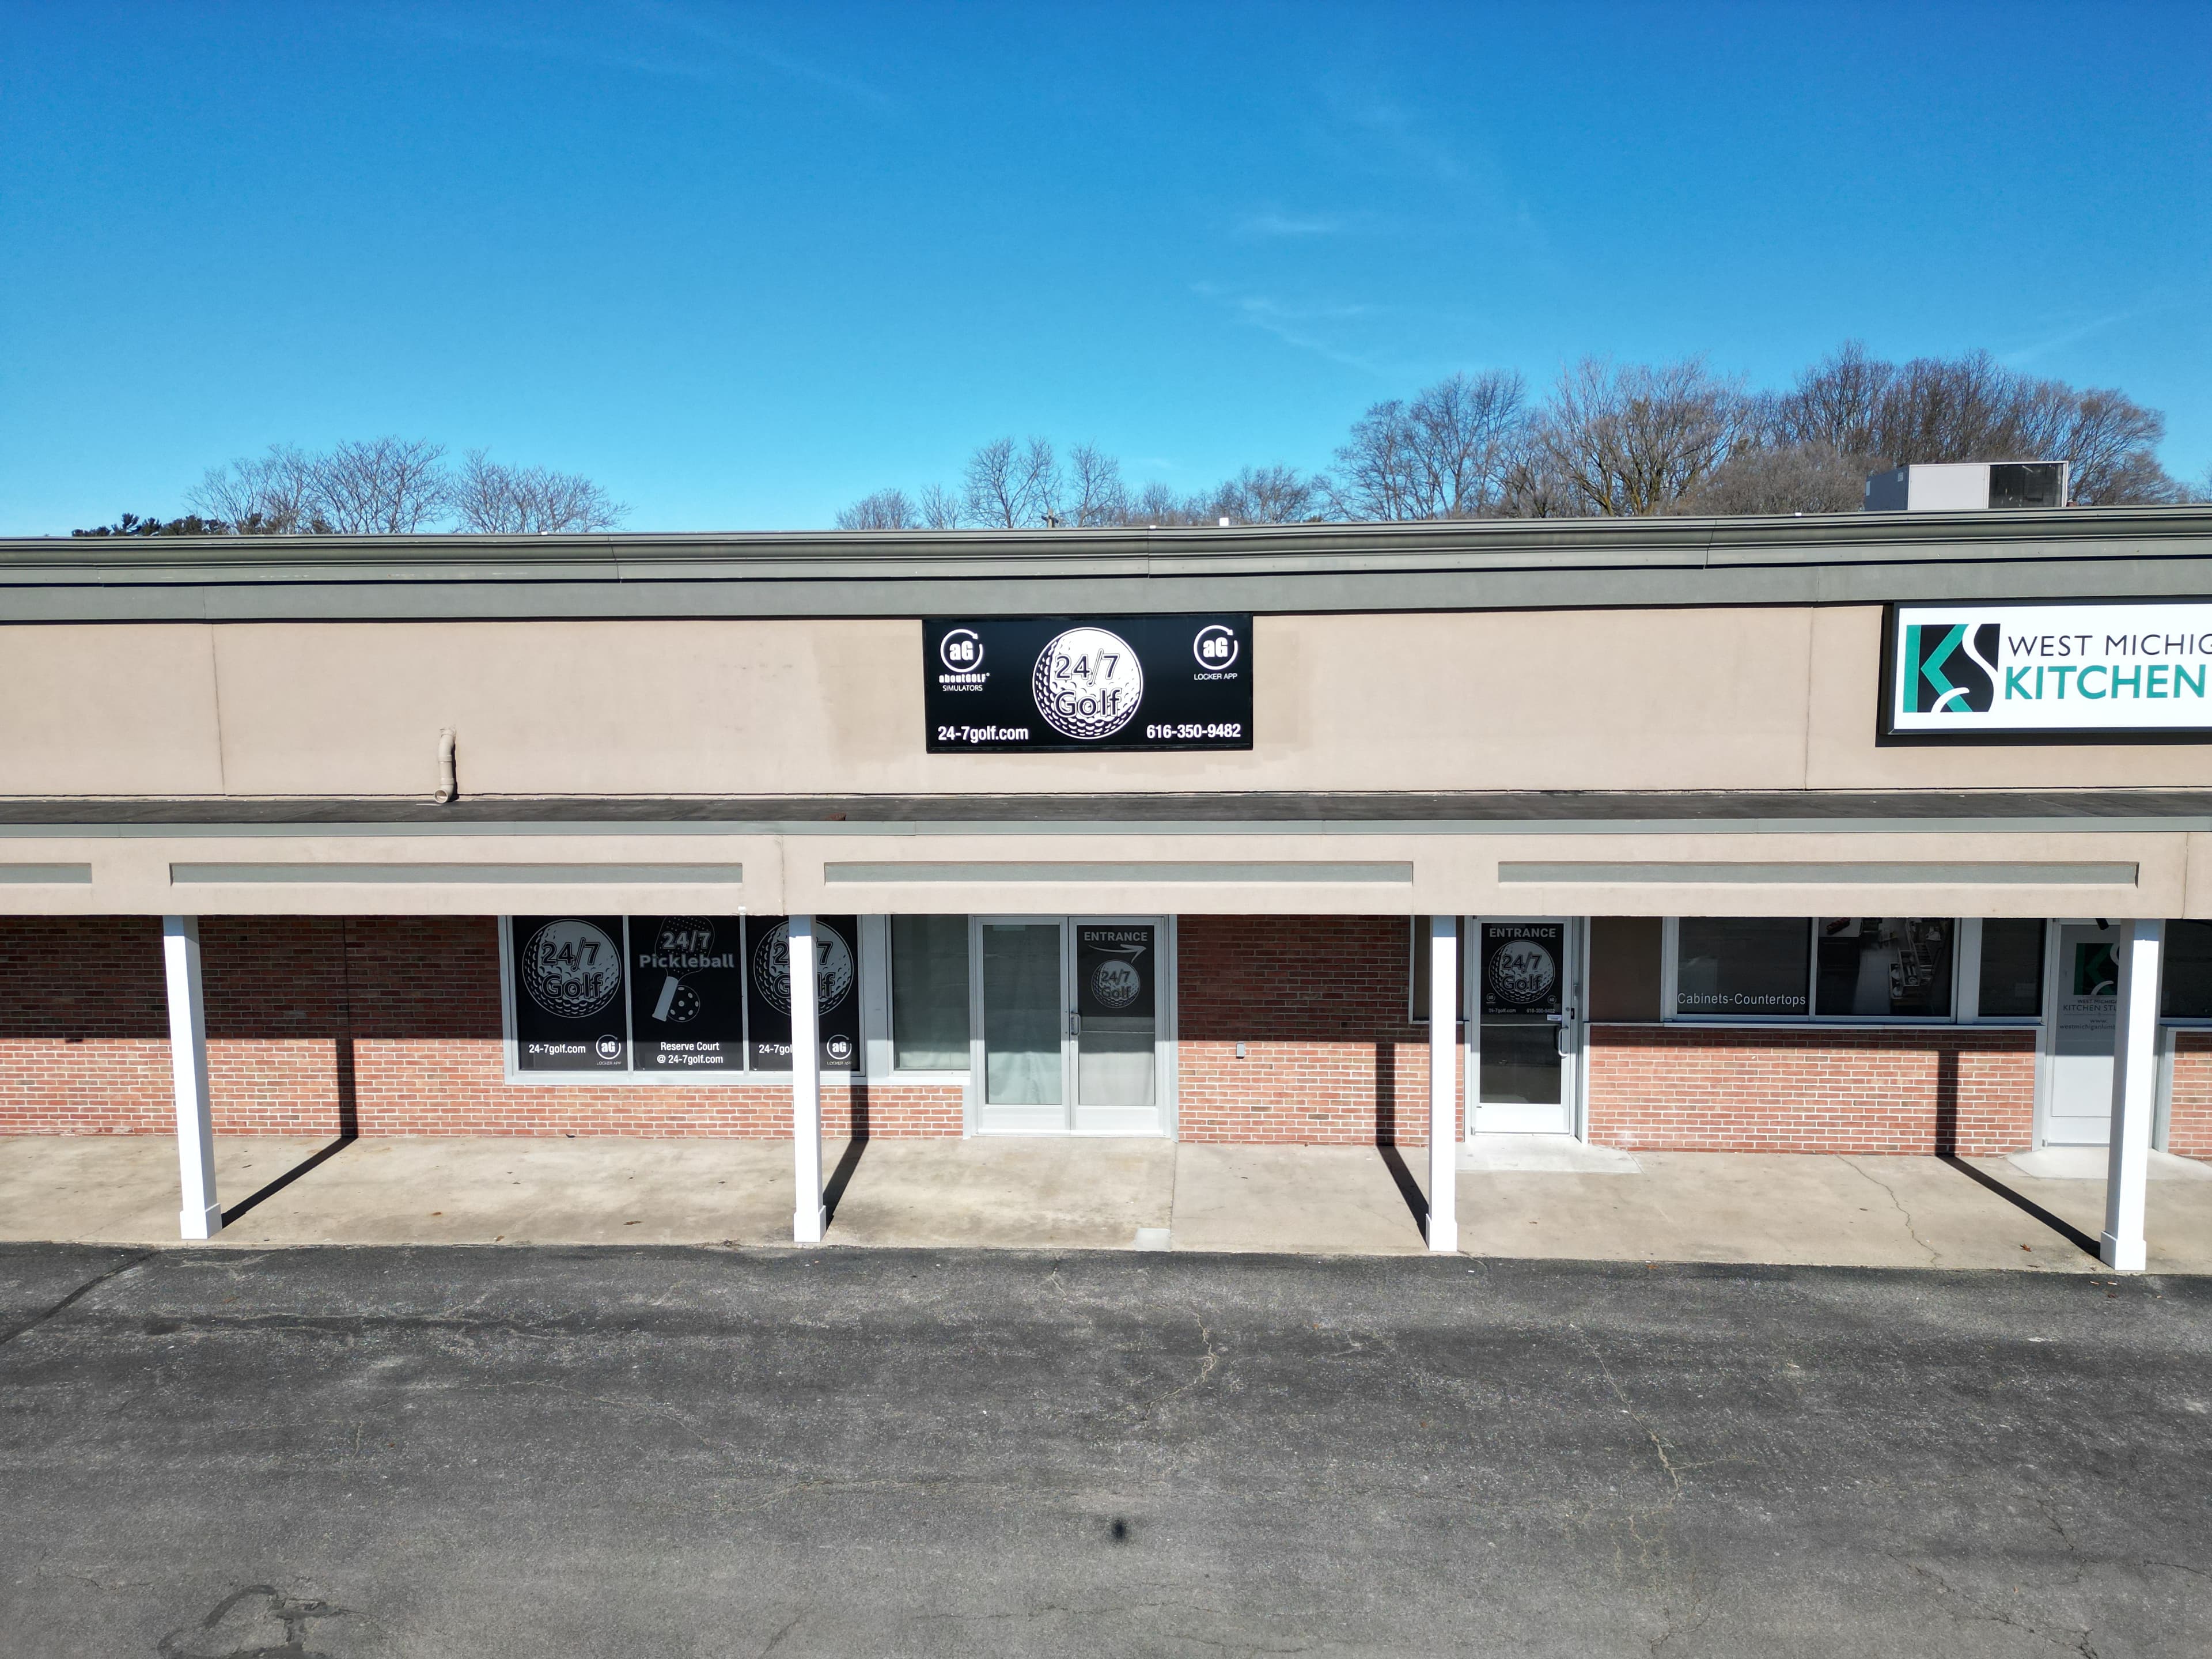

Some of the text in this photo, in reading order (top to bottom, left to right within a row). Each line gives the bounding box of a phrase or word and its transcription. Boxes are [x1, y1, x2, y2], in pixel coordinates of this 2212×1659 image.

[949, 641, 973, 660] aG
[1203, 637, 1228, 657] aG
[2008, 634, 2212, 657] WEST MICHIG
[1055, 648, 1120, 687] 24/7
[2005, 664, 2206, 699] KITCHEN
[1054, 688, 1123, 718] Golf
[938, 726, 1029, 743] 24-7golf.com
[1147, 724, 1241, 739] 616-350-9482
[662, 930, 711, 952] 24/7
[1084, 931, 1148, 941] ENTRANCE
[1489, 928, 1556, 938] ENTRANCE
[541, 937, 601, 972] 24/7
[639, 953, 735, 968] Pickleball
[773, 941, 834, 965] 27
[1502, 951, 1542, 974] 24/7
[541, 972, 604, 999] Golf
[773, 972, 836, 999] Glf
[1101, 968, 1131, 986] 24/7
[1502, 974, 1543, 991] Golf
[1101, 986, 1131, 998] Golf
[1677, 993, 1806, 1007] Cabinets-Countertops
[529, 1044, 586, 1055] 24-7golf.com
[601, 1041, 616, 1053] aG
[660, 1041, 719, 1051] Reserve Court
[832, 1041, 847, 1053] aG
[657, 1054, 724, 1065] @ 24-7golf.com
